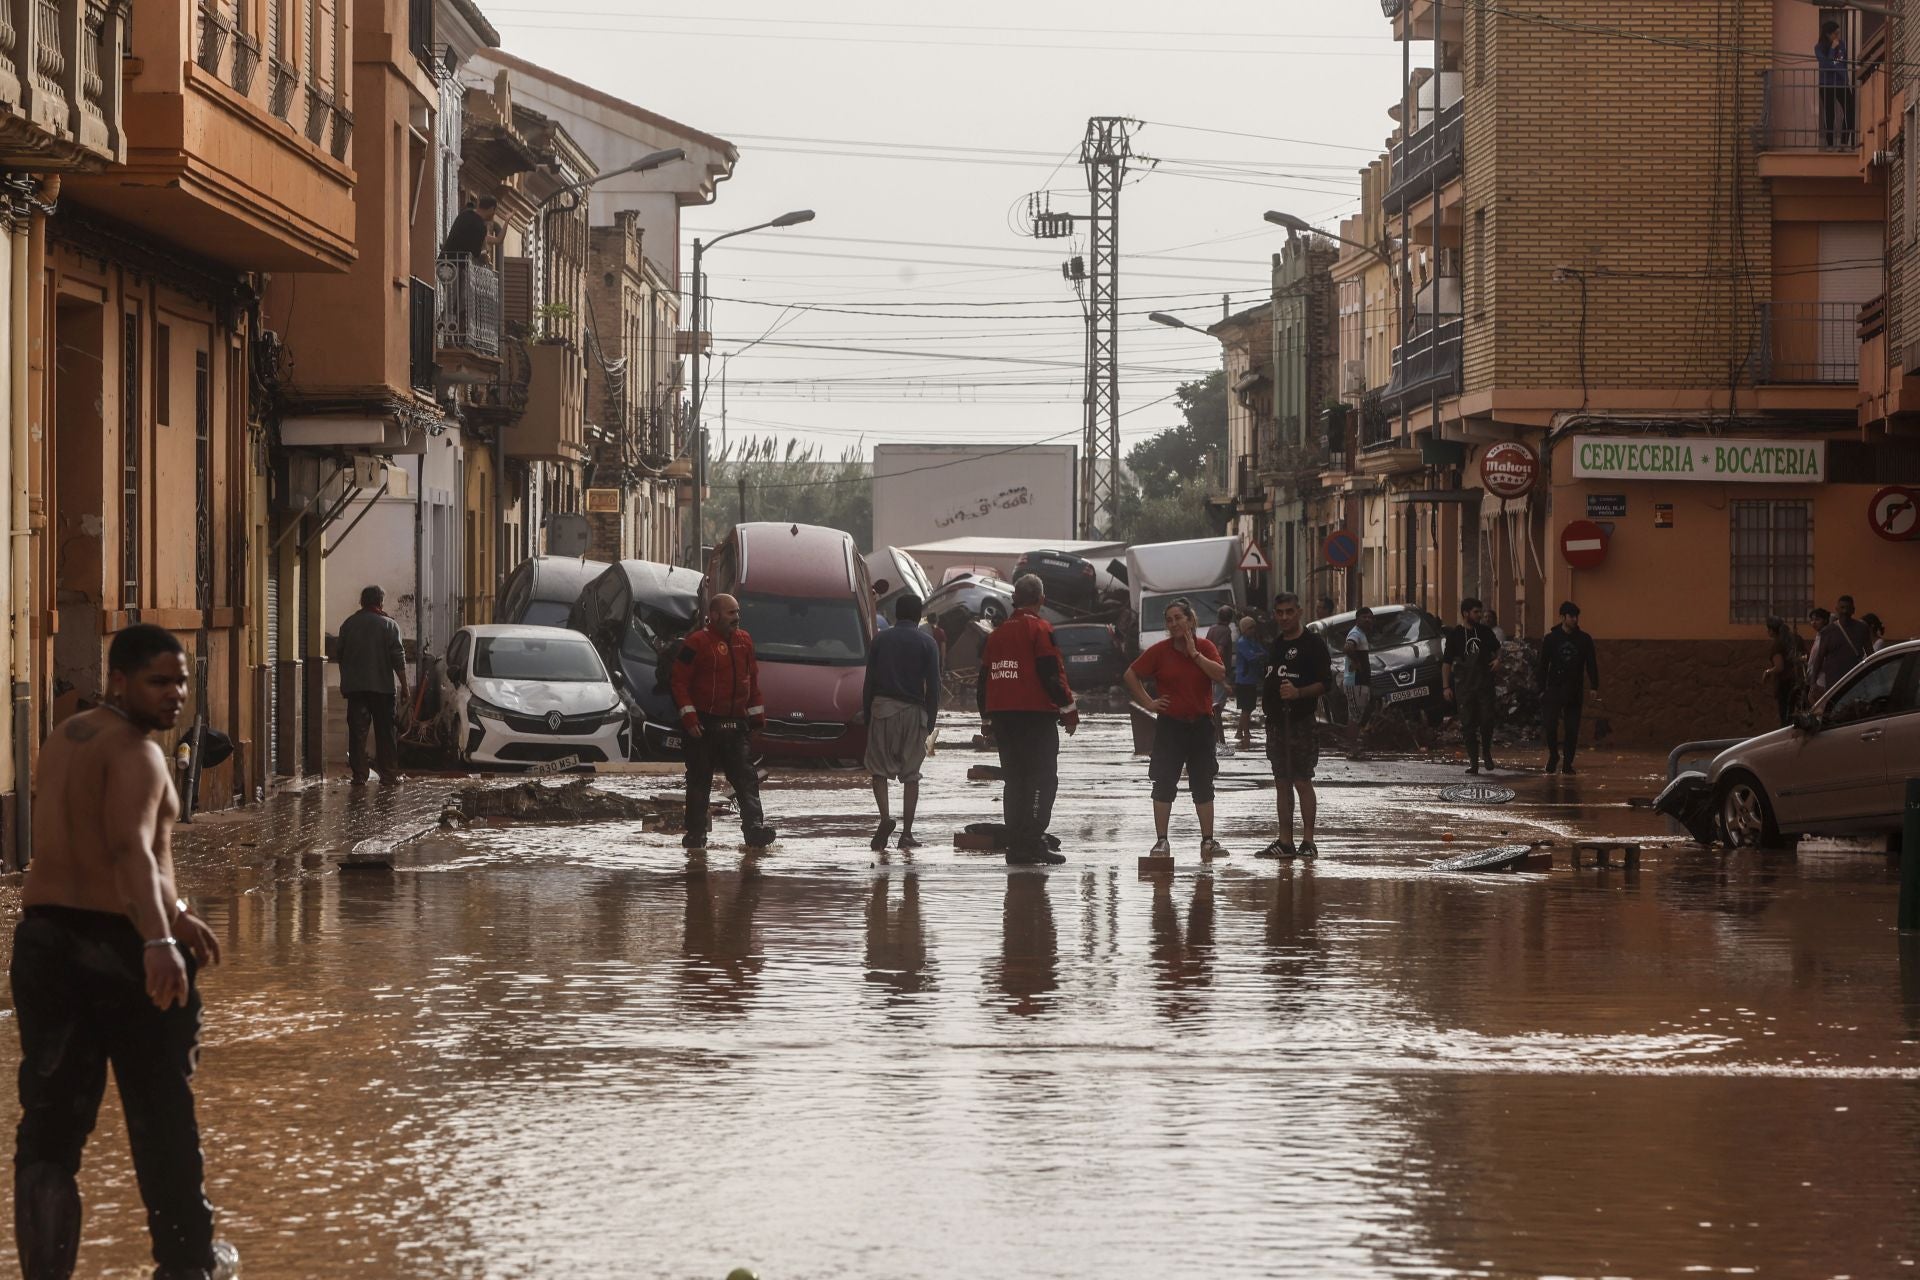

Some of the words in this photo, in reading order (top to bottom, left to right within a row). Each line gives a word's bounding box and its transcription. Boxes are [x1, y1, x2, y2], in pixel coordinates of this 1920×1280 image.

[1580, 443, 1694, 472] CERVECERIA
[1715, 446, 1819, 475] BOCATERIA
[1486, 461, 1531, 472] Mahou
[559, 755, 578, 769] MSJ
